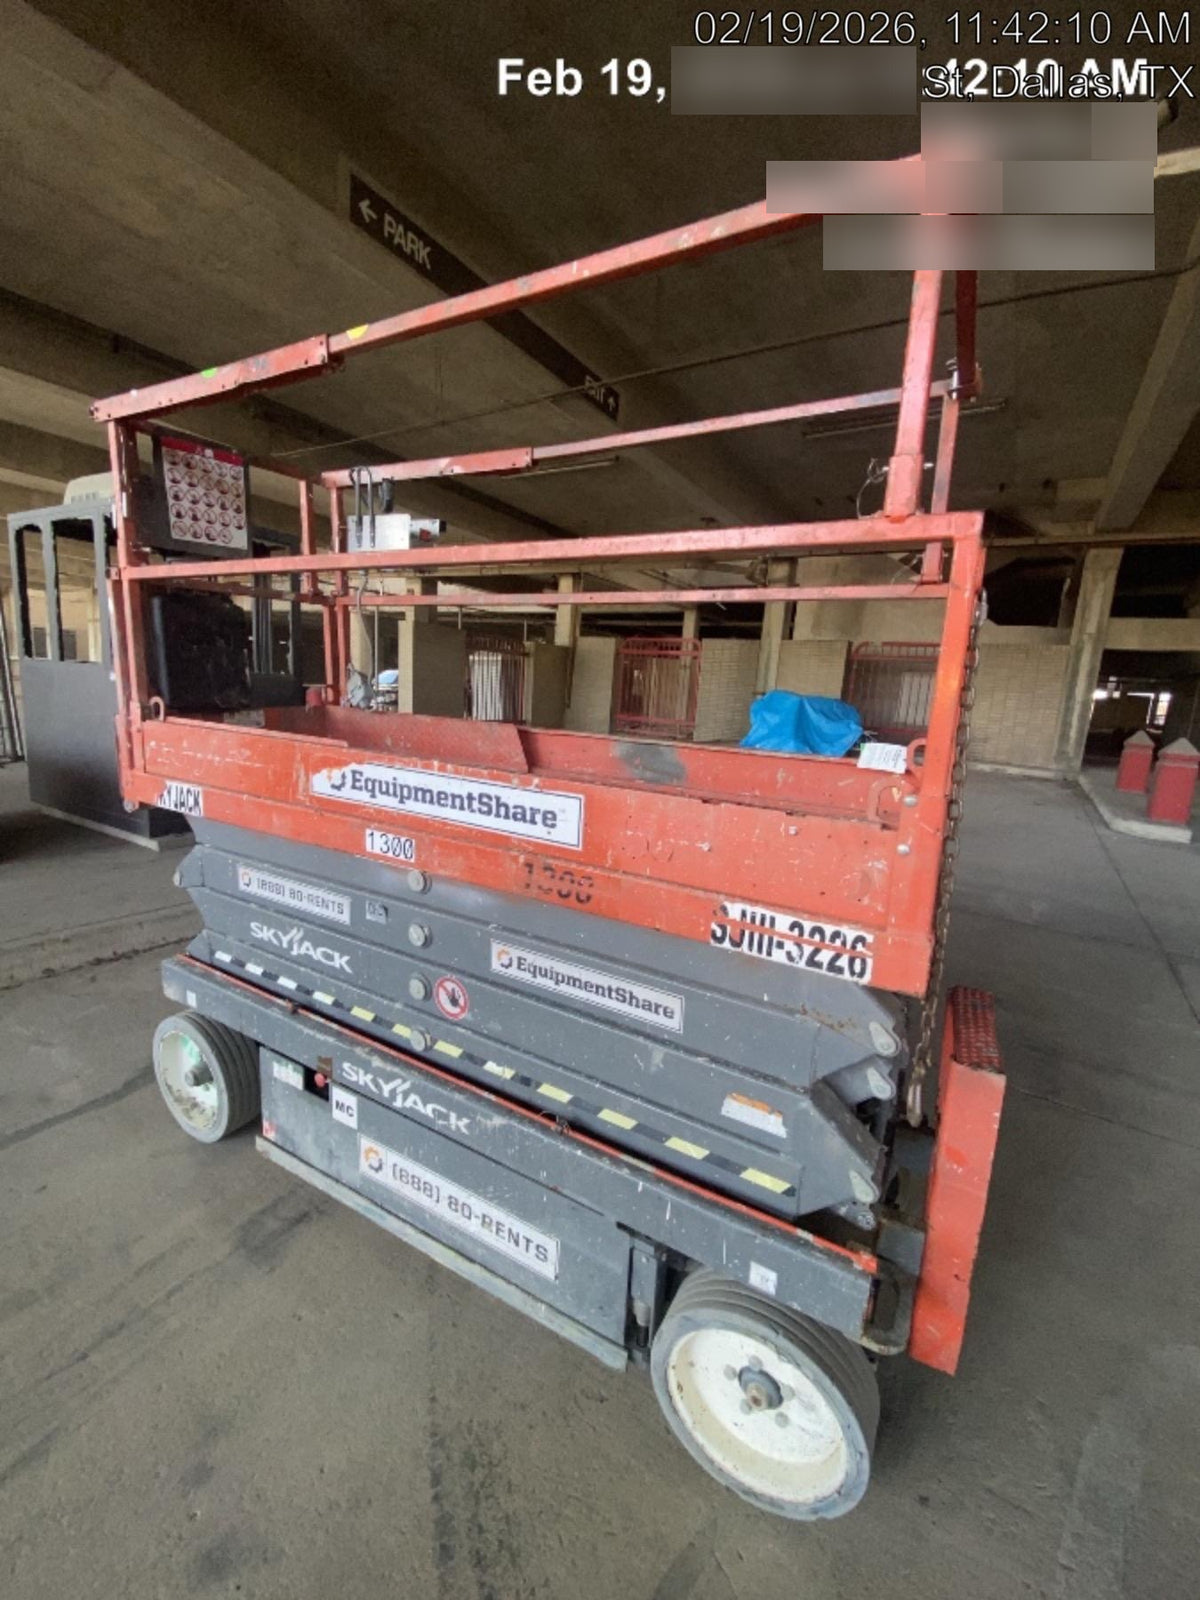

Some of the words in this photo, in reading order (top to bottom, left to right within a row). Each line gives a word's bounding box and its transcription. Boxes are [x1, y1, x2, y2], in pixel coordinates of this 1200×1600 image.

[383, 212, 431, 270] PARK
[350, 768, 559, 829] EquipmentShare
[368, 831, 414, 860] 1300
[250, 921, 353, 974] SKYJACK
[516, 956, 675, 1020] EquipmentShare
[335, 1099, 355, 1118] MC
[341, 1062, 470, 1136] SKYJACK
[447, 1192, 549, 1263] 80-RENTS
